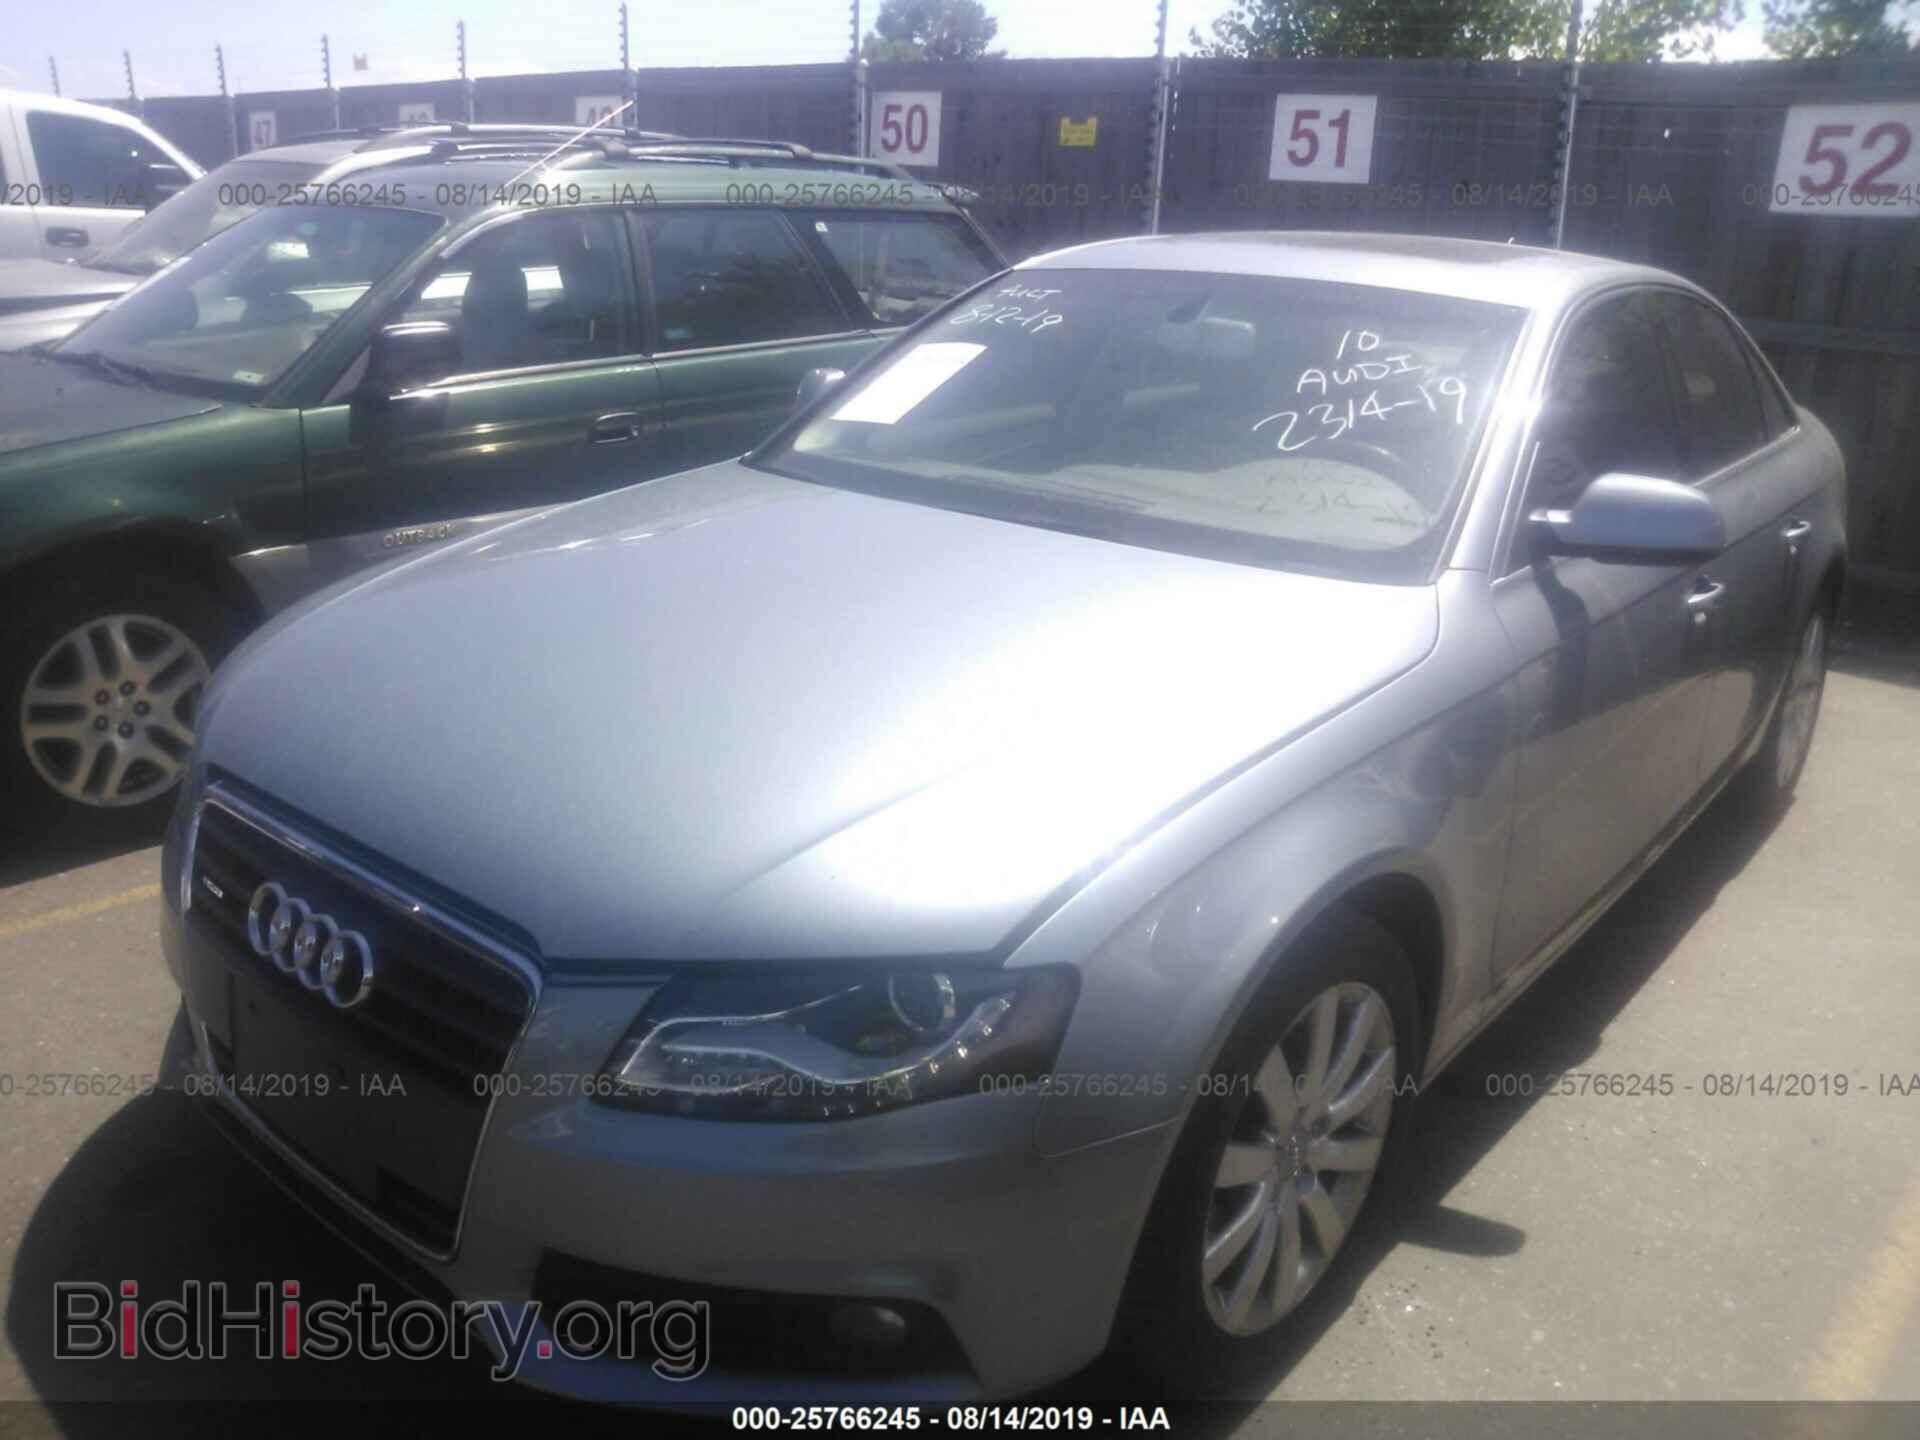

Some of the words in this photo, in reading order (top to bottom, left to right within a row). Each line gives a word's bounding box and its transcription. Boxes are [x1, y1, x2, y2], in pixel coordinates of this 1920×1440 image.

[881, 103, 929, 154] 50
[1287, 109, 1351, 168] 51
[1798, 121, 1912, 195] 52
[1336, 329, 1380, 360] 10
[1296, 354, 1422, 394] AUDI
[1253, 376, 1467, 452] 2314-19
